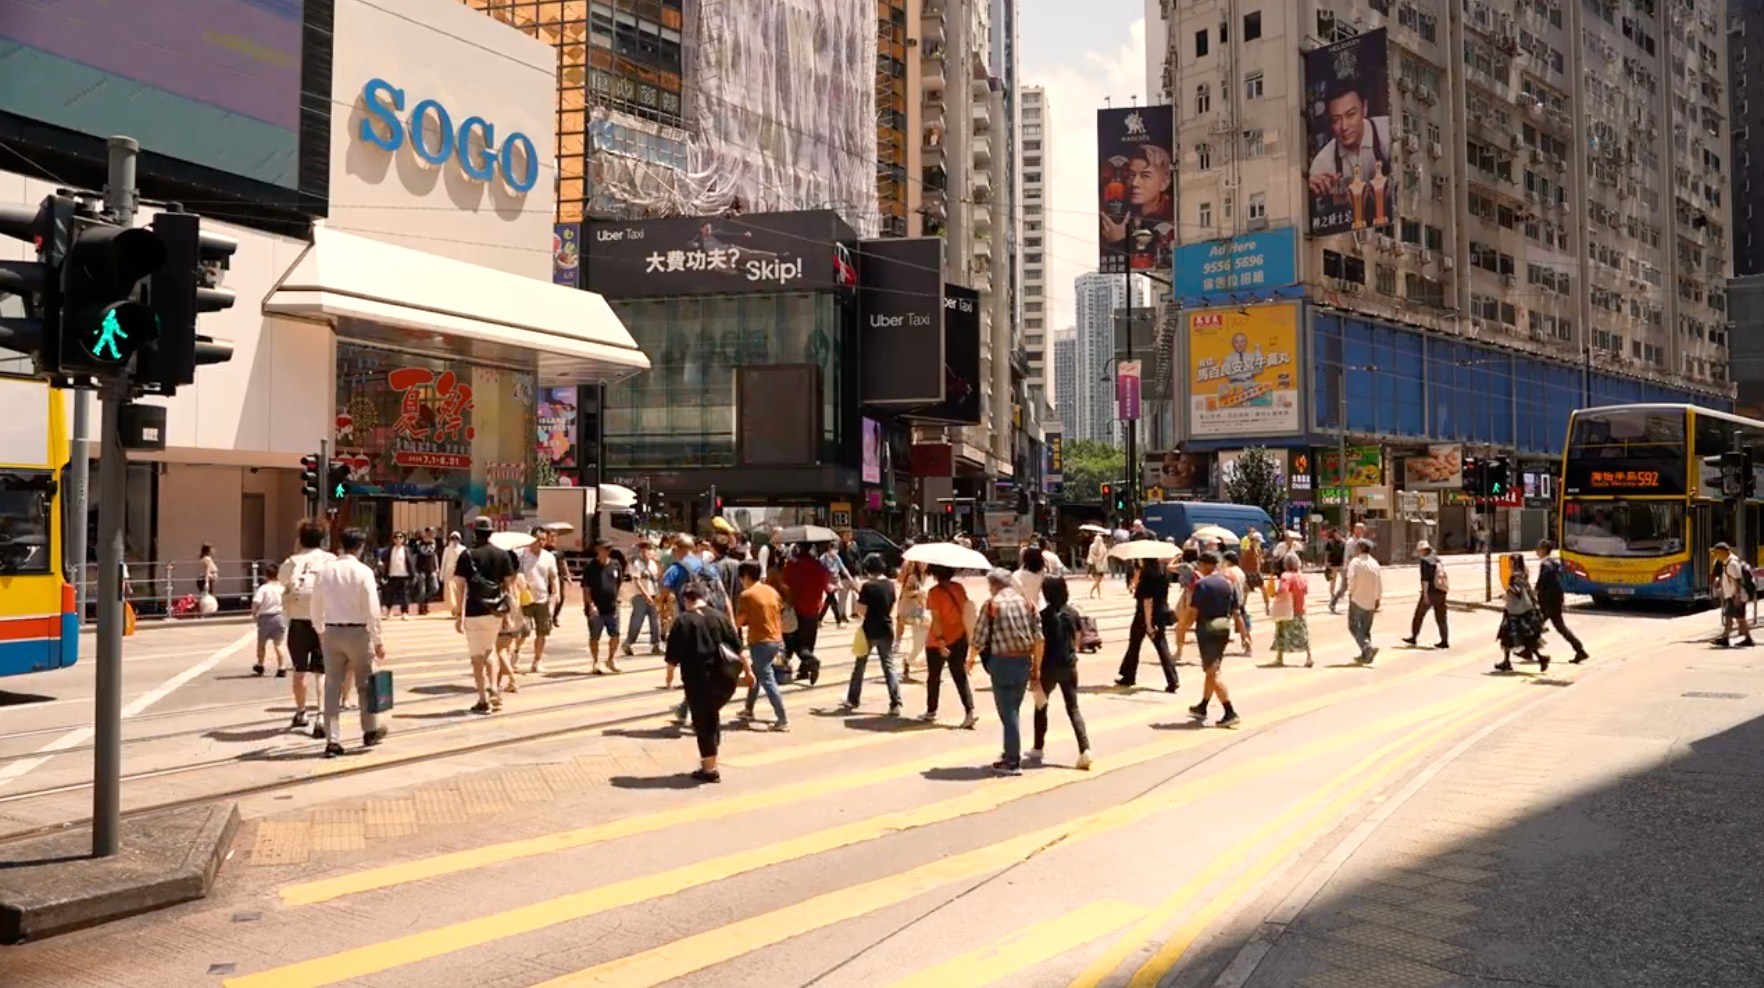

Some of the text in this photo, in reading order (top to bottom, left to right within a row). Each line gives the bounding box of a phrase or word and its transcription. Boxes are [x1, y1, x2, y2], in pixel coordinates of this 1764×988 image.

[361, 78, 538, 193] SOGO
[597, 228, 645, 241] Uber Taxi
[1209, 241, 1257, 257] Ad Here
[646, 248, 740, 273] 大費功夫?
[1203, 254, 1264, 274] 9556 5696
[746, 258, 802, 284] Skip!
[959, 298, 973, 312] Taxi
[870, 312, 931, 327] Uber Taxi
[1638, 471, 1659, 487] 592
